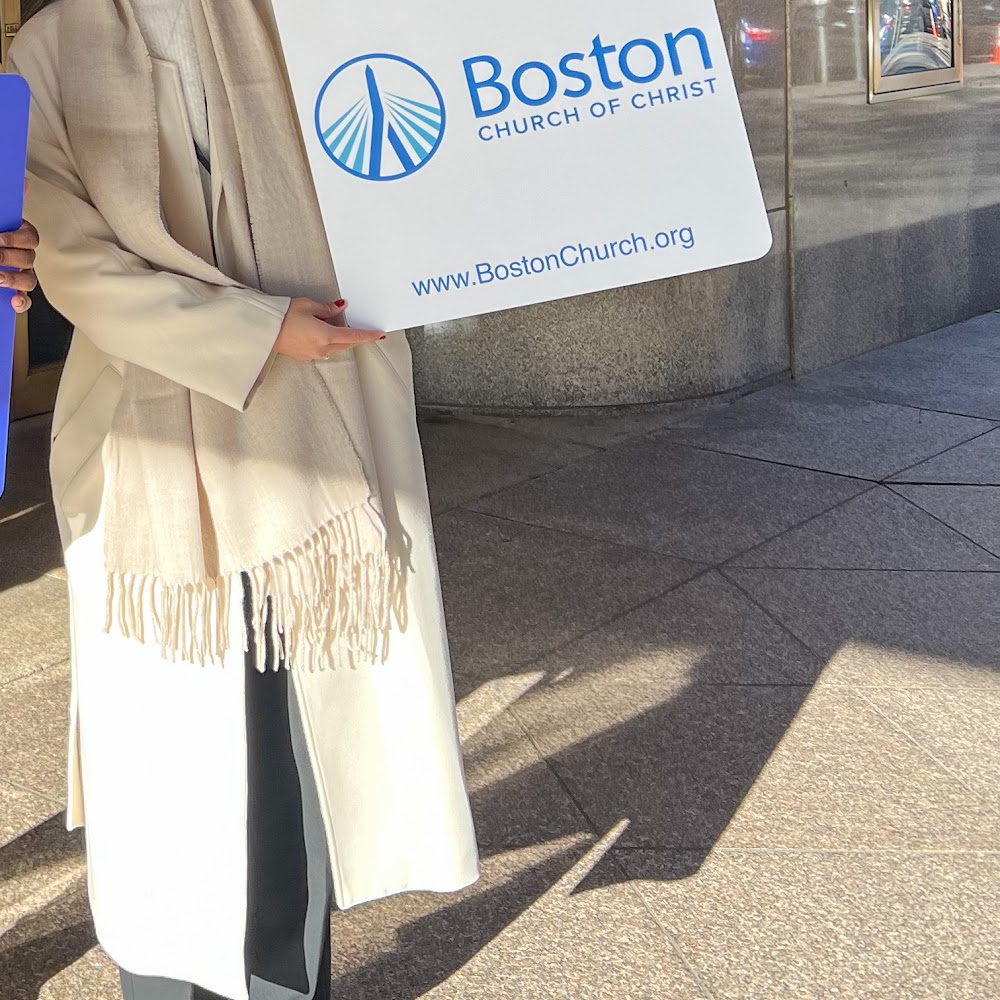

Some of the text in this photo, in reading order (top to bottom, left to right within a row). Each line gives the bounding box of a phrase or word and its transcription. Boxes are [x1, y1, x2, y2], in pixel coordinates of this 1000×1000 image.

[462, 27, 713, 119] Boston
[478, 77, 717, 141] CHURCH OF CHRIST
[411, 226, 696, 297] www.BostonChurch.org
